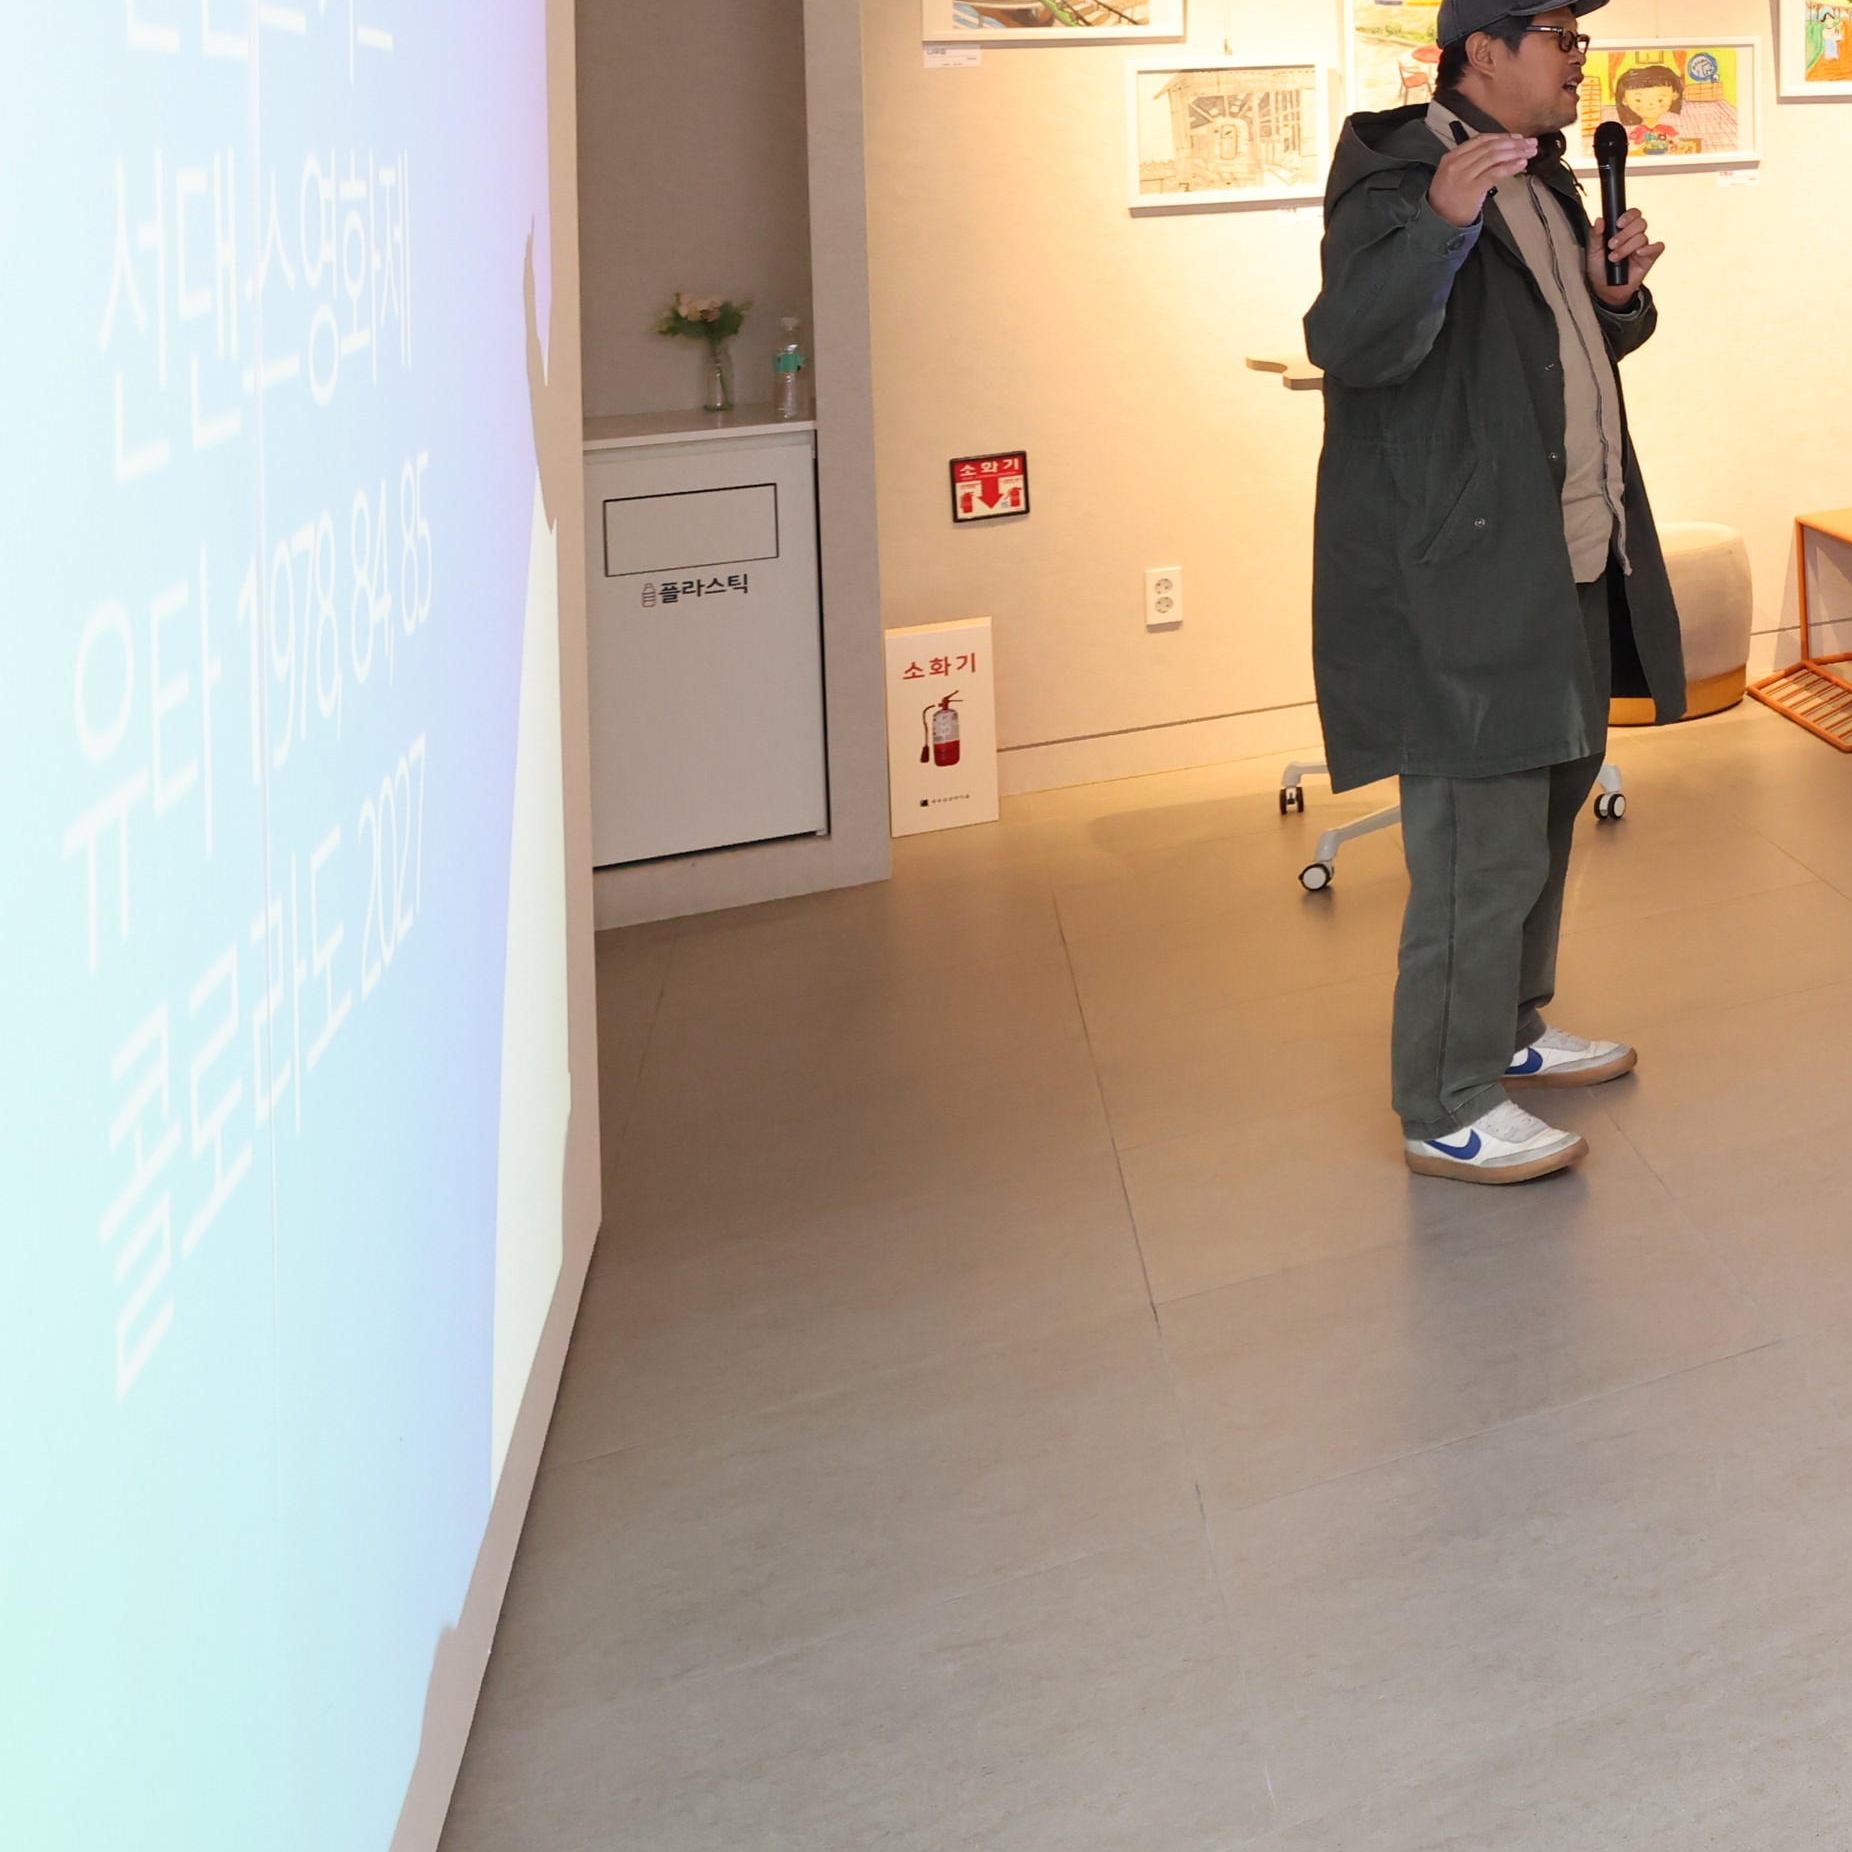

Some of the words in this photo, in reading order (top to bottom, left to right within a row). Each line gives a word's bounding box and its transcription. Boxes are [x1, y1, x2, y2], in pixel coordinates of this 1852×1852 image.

[98, 146, 411, 484] 선댄스영화제
[959, 458, 1019, 477] 소화기
[658, 573, 748, 603] 플라스틱
[902, 652, 976, 680] 소화기
[62, 541, 222, 976] 유타
[401, 453, 432, 636] 85
[97, 822, 353, 1403] 콜로라도
[357, 730, 428, 1004] 2027
